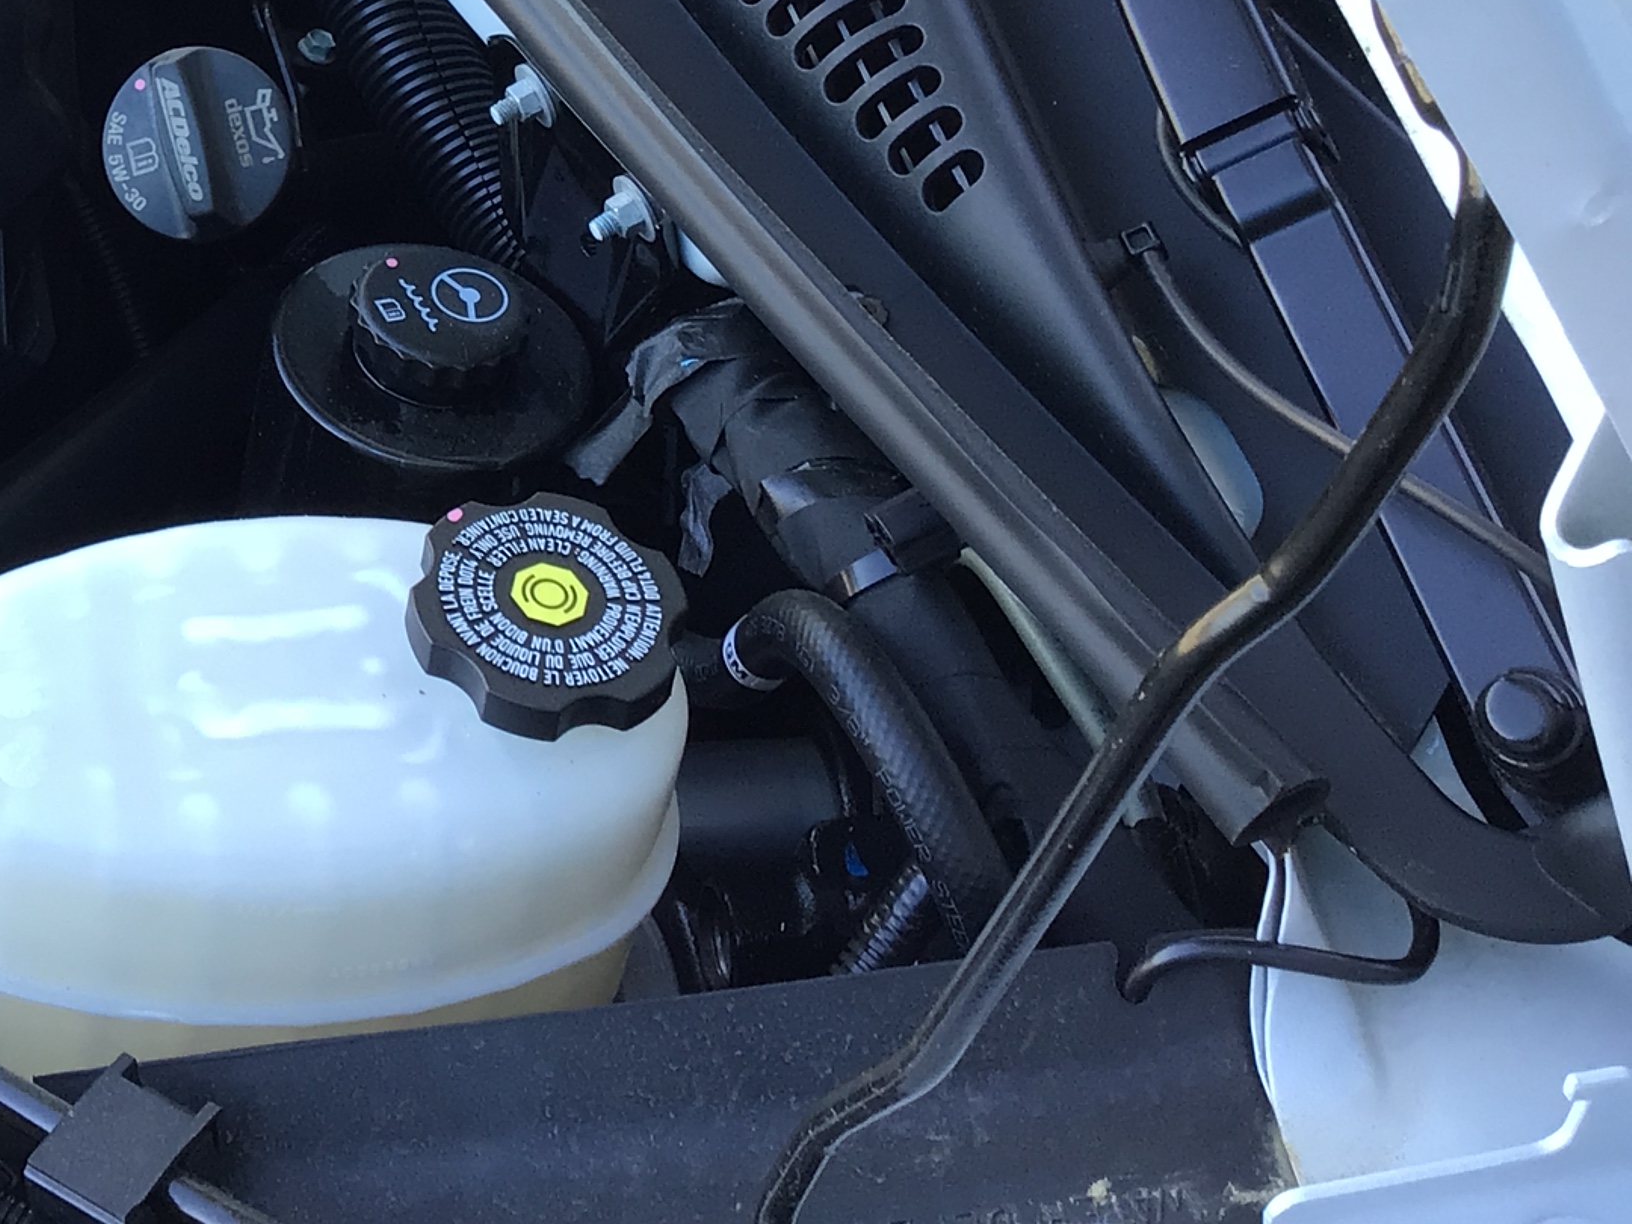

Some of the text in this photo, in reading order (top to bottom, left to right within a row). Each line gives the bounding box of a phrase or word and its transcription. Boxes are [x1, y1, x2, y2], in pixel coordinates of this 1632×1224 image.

[161, 77, 204, 203] ACDelco
[224, 97, 254, 169] dexos
[106, 111, 148, 212] SAE 5W-30
[452, 508, 660, 600] DOT4 FLUID FROM A SEALED CONTAINER.
[469, 523, 641, 600] CAP BEFORE REMOVING. USE ONLY
[486, 538, 621, 598] WARNING: CLEAN FILLER
[457, 559, 480, 585] DOT4
[440, 594, 458, 609] LA
[458, 588, 482, 620] FREIN
[446, 612, 481, 645] AVANT
[474, 619, 495, 637] DE
[489, 612, 528, 644] BIDON
[569, 603, 622, 652] PROVENANT
[625, 603, 662, 660] ATTENTION:
[490, 634, 540, 665] LIQUIDE
[531, 635, 564, 653] D'UN
[476, 643, 538, 681] BOUCHON
[545, 654, 564, 669] DU
[564, 657, 629, 686] NETTOYER
[568, 652, 595, 669] QUE
[543, 669, 560, 685] LE
[874, 767, 935, 864] POWER
